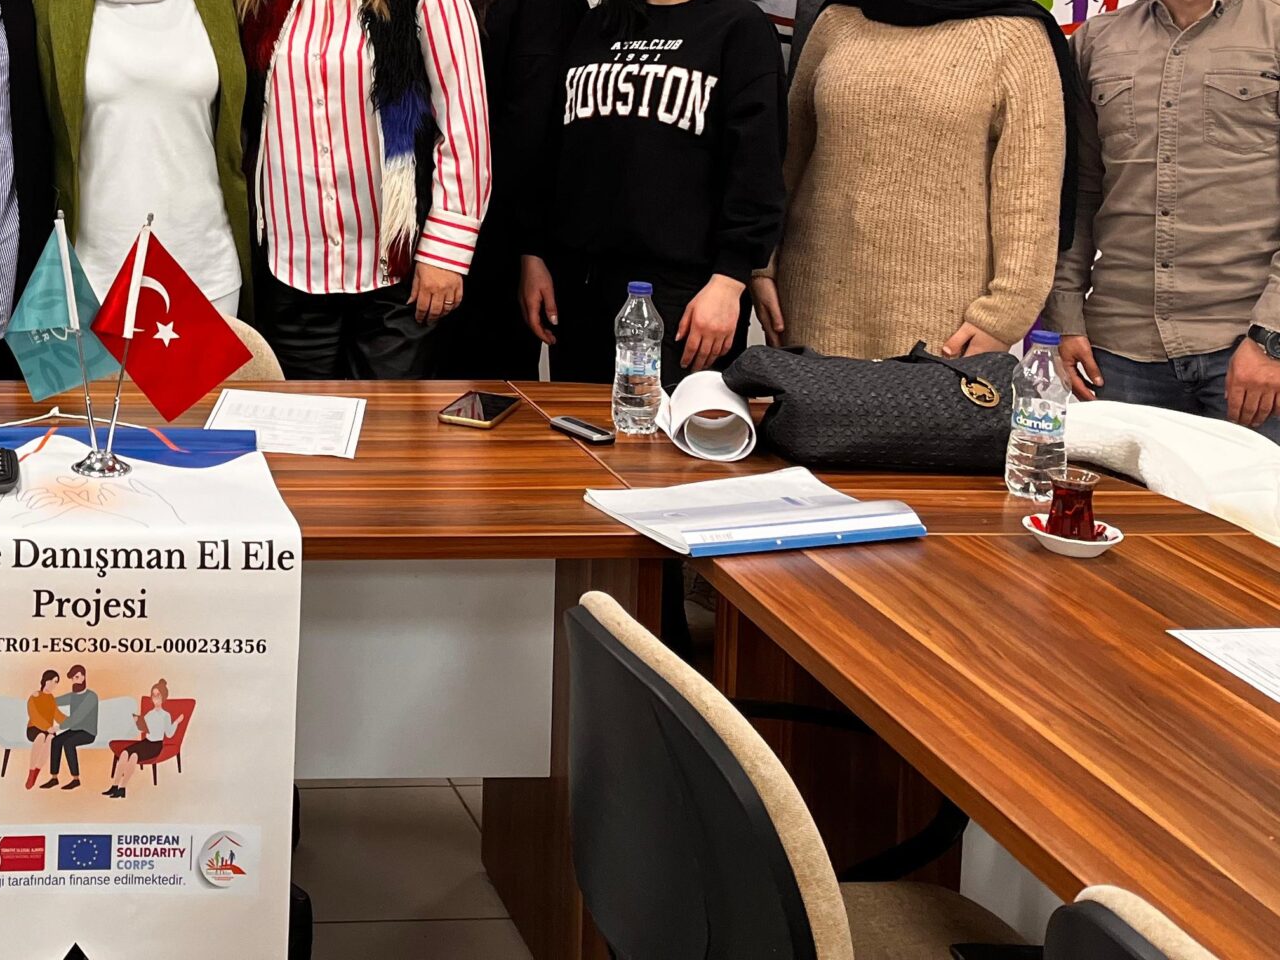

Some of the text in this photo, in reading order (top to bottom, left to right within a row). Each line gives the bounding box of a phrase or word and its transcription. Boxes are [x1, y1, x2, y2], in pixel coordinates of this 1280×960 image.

[563, 63, 718, 136] HOUSTON
[1016, 414, 1053, 430] damla
[11, 538, 187, 578] Danışman
[196, 539, 232, 570] El
[241, 539, 295, 571] Ele
[31, 588, 148, 627] Projesi
[117, 835, 180, 846] EUROPEAN
[117, 847, 186, 858] SOLIDARITY
[117, 859, 155, 871] CORPS
[8, 874, 66, 887] tarafından
[70, 874, 110, 886] finanse
[114, 873, 186, 886] edilmektedir.
